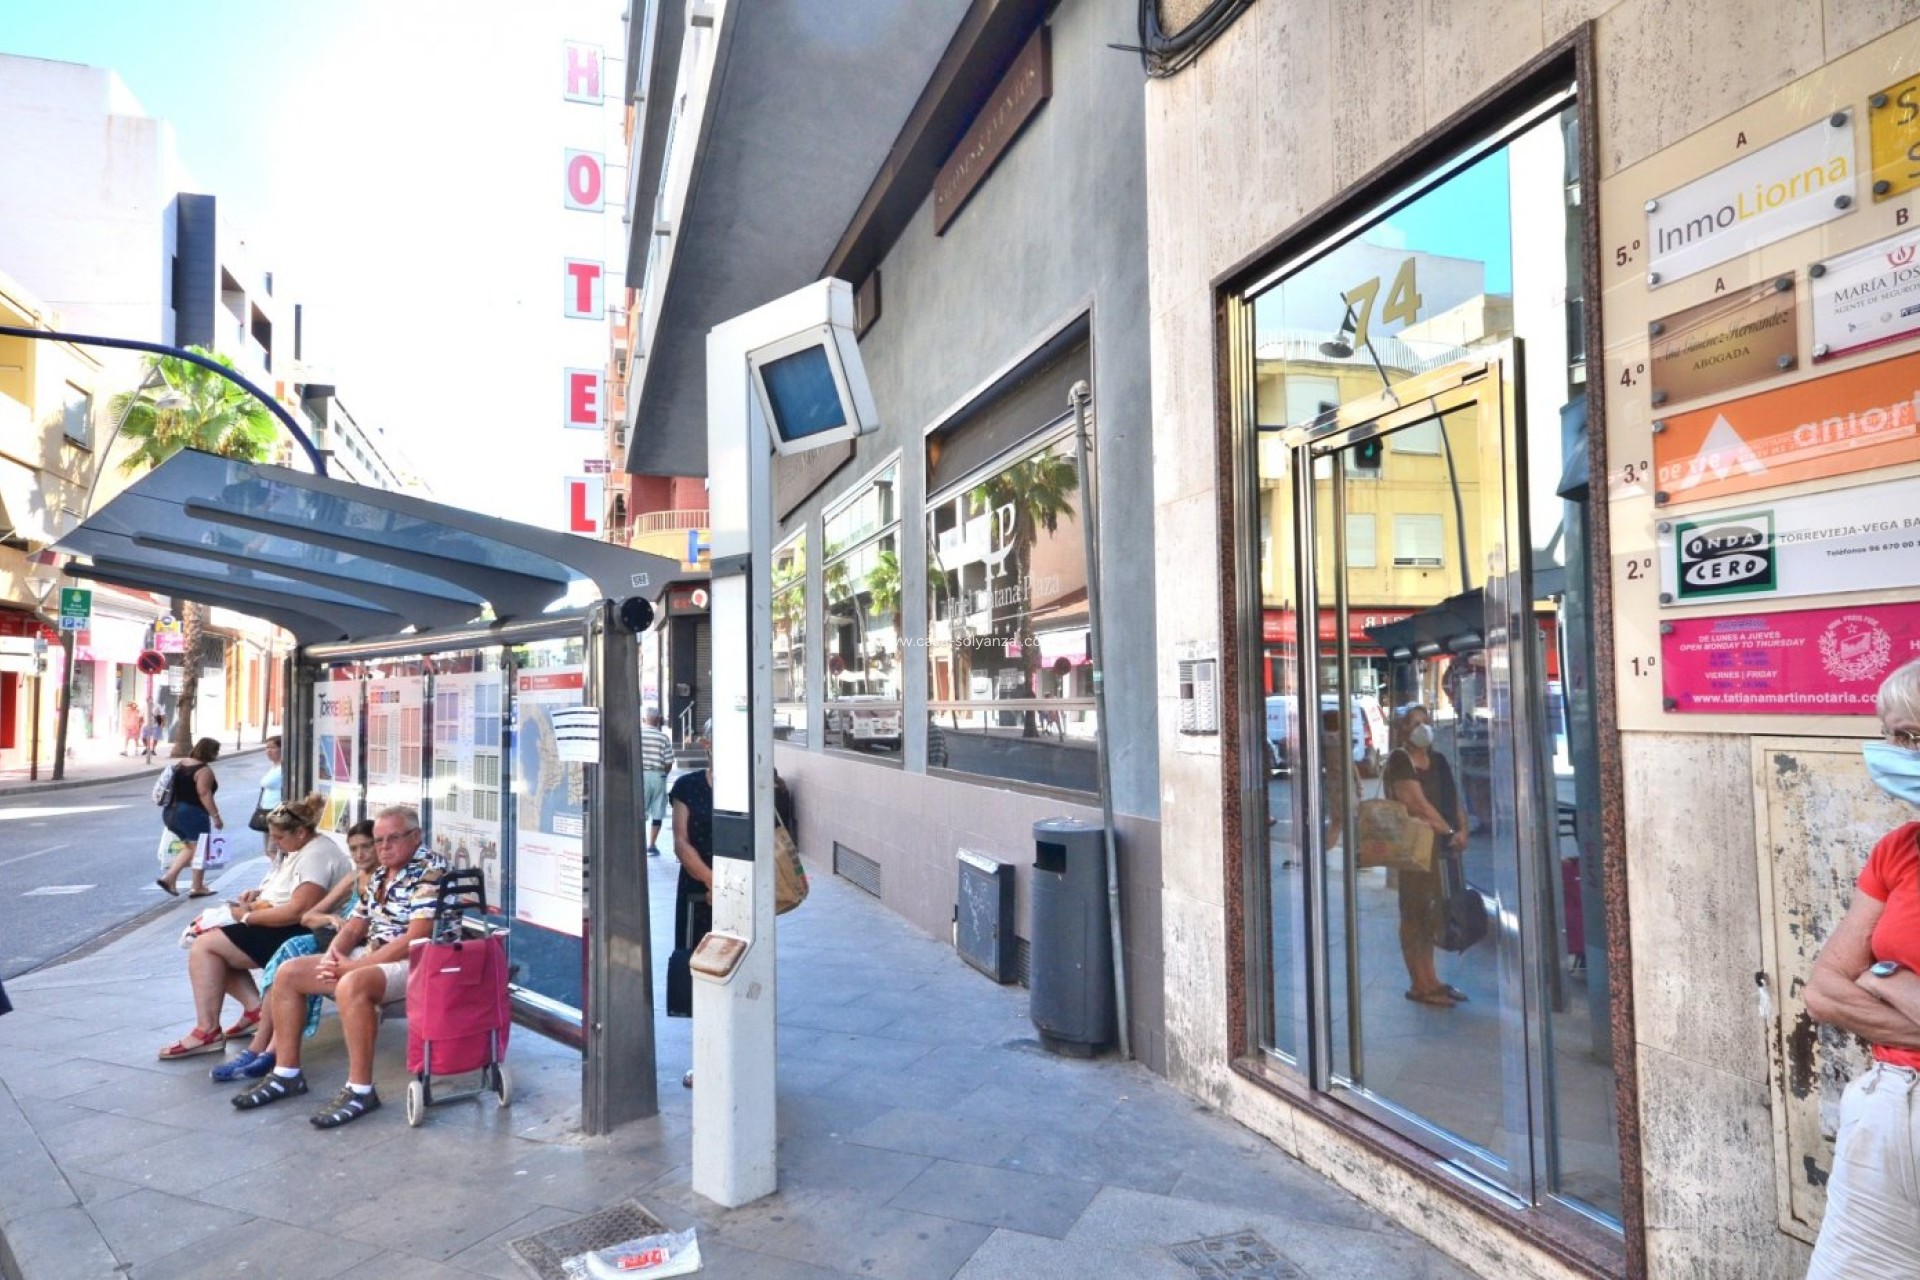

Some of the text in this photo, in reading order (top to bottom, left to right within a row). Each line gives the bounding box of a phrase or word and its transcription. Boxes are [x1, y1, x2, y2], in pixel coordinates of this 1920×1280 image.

[1736, 132, 1747, 148] A
[1659, 155, 1847, 253] InmoLiorna
[1896, 208, 1909, 226] B
[1616, 239, 1641, 267] 5.º
[567, 47, 600, 532] HOTEL
[1715, 277, 1726, 293] A
[1346, 257, 1422, 348] 74
[1693, 346, 1750, 370] ABOGADA
[1620, 364, 1645, 388] 4.º
[1623, 460, 1648, 484] 3.º
[1691, 534, 1756, 553] ONDA
[1626, 558, 1651, 581] 2.º
[1696, 559, 1757, 581] CERO
[1680, 638, 1806, 651] OPEN MONDAY TO THURSDAY
[1711, 633, 1737, 642] LUNES
[1747, 631, 1781, 640] JUEVES
[1630, 656, 1655, 678] 1.º
[1705, 670, 1778, 679] VIERNES FRIDAY
